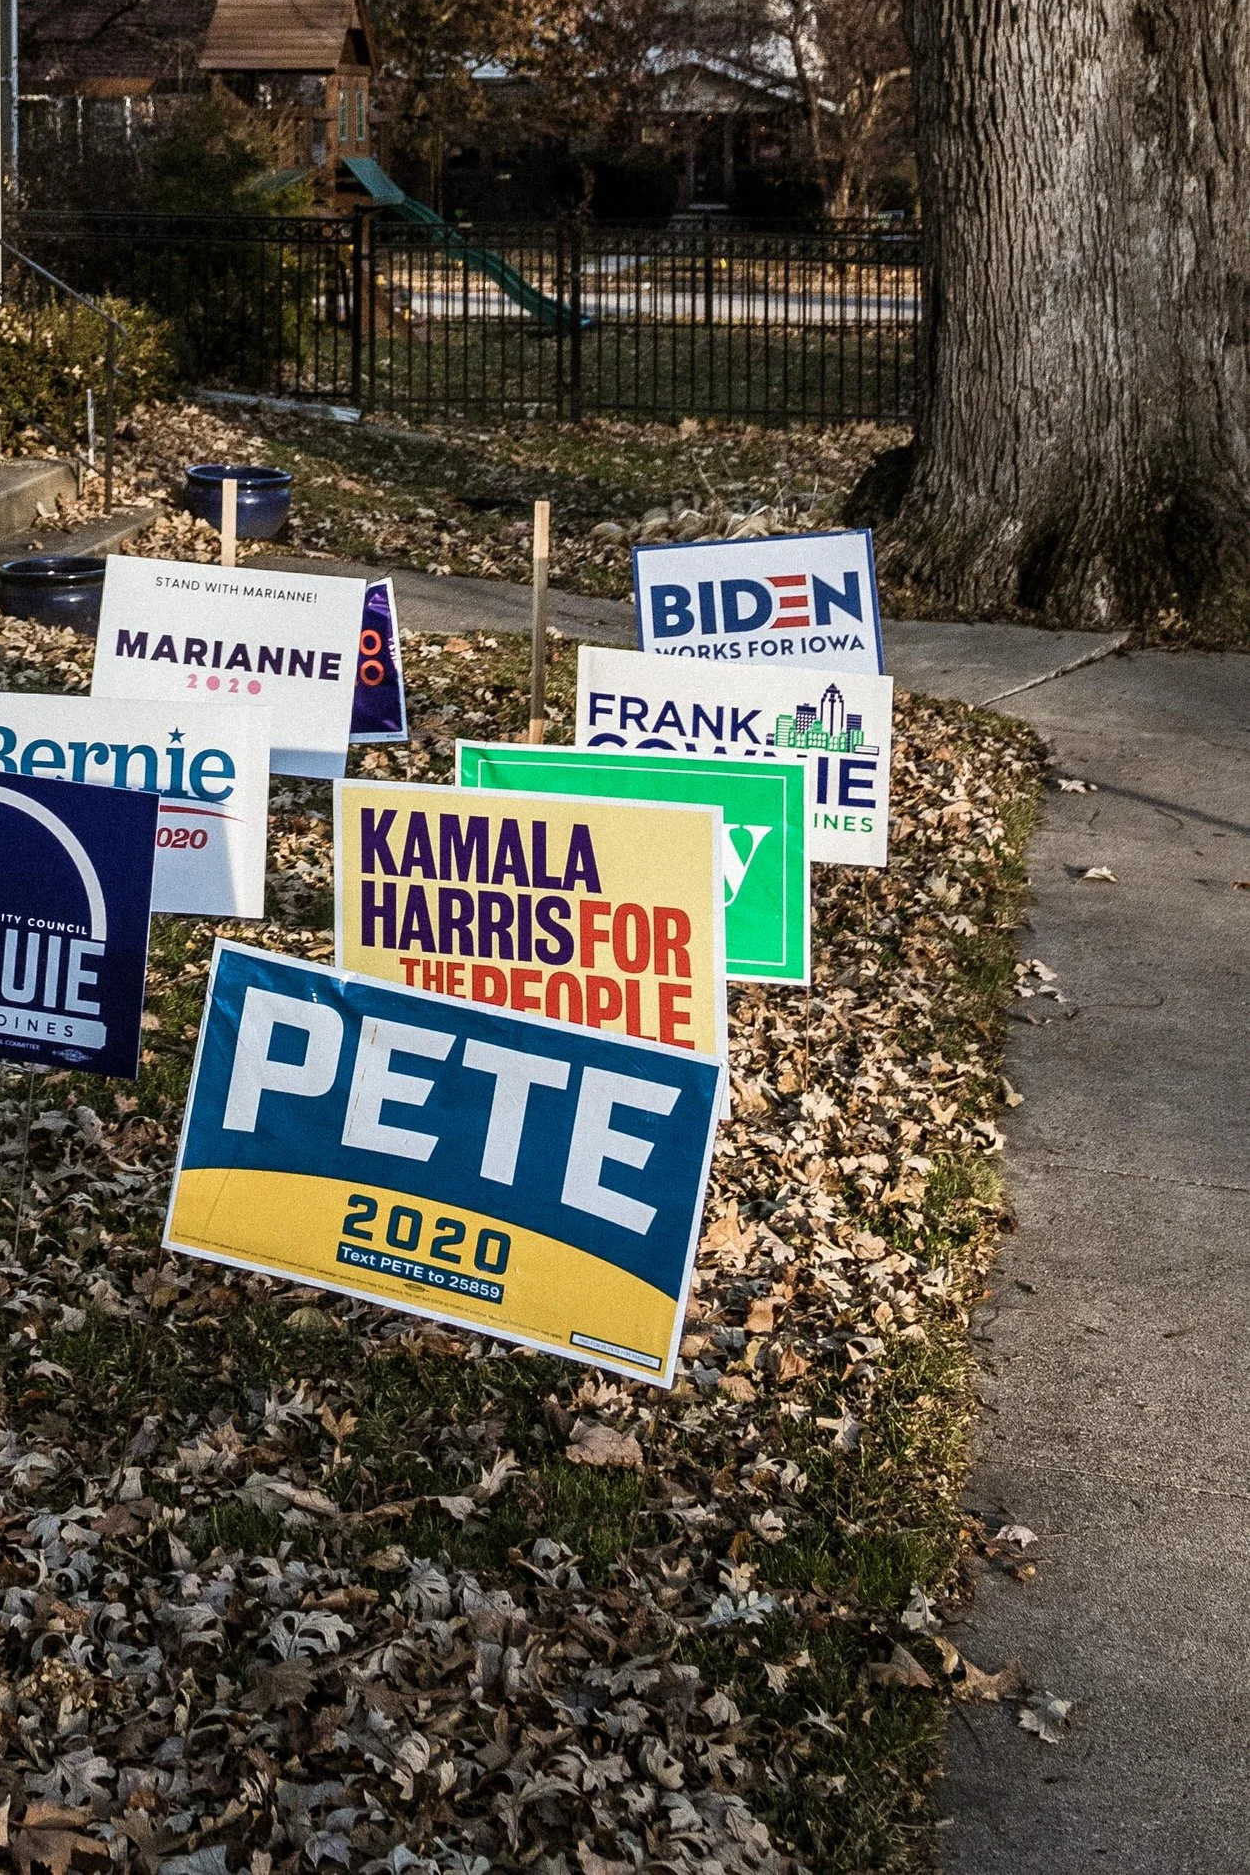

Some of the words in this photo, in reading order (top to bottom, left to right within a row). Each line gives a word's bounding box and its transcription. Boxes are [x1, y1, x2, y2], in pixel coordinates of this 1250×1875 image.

[156, 576, 200, 591] STAND
[205, 582, 239, 596] WITH
[243, 586, 318, 604] MARIANNE!
[650, 570, 863, 639] BIDEN
[114, 629, 342, 681] MARIANNE
[748, 639, 794, 658] FOR
[801, 634, 865, 654] IOWA
[186, 673, 262, 695] 2020
[589, 691, 763, 745] FRANK
[156, 827, 208, 849] 020
[813, 812, 874, 834] INES
[359, 807, 602, 894] KAMALA
[27, 917, 88, 935] COUNCIL
[359, 880, 573, 966] HARRIS
[578, 899, 693, 978] FOR
[399, 957, 467, 999] THE
[471, 964, 695, 1050] PEOPLE
[222, 985, 682, 1236] PETE
[342, 1193, 512, 1276] 2020
[342, 1245, 377, 1267] Text
[381, 1256, 424, 1281] PETE
[427, 1269, 446, 1285] to
[449, 1275, 501, 1300] 25859
